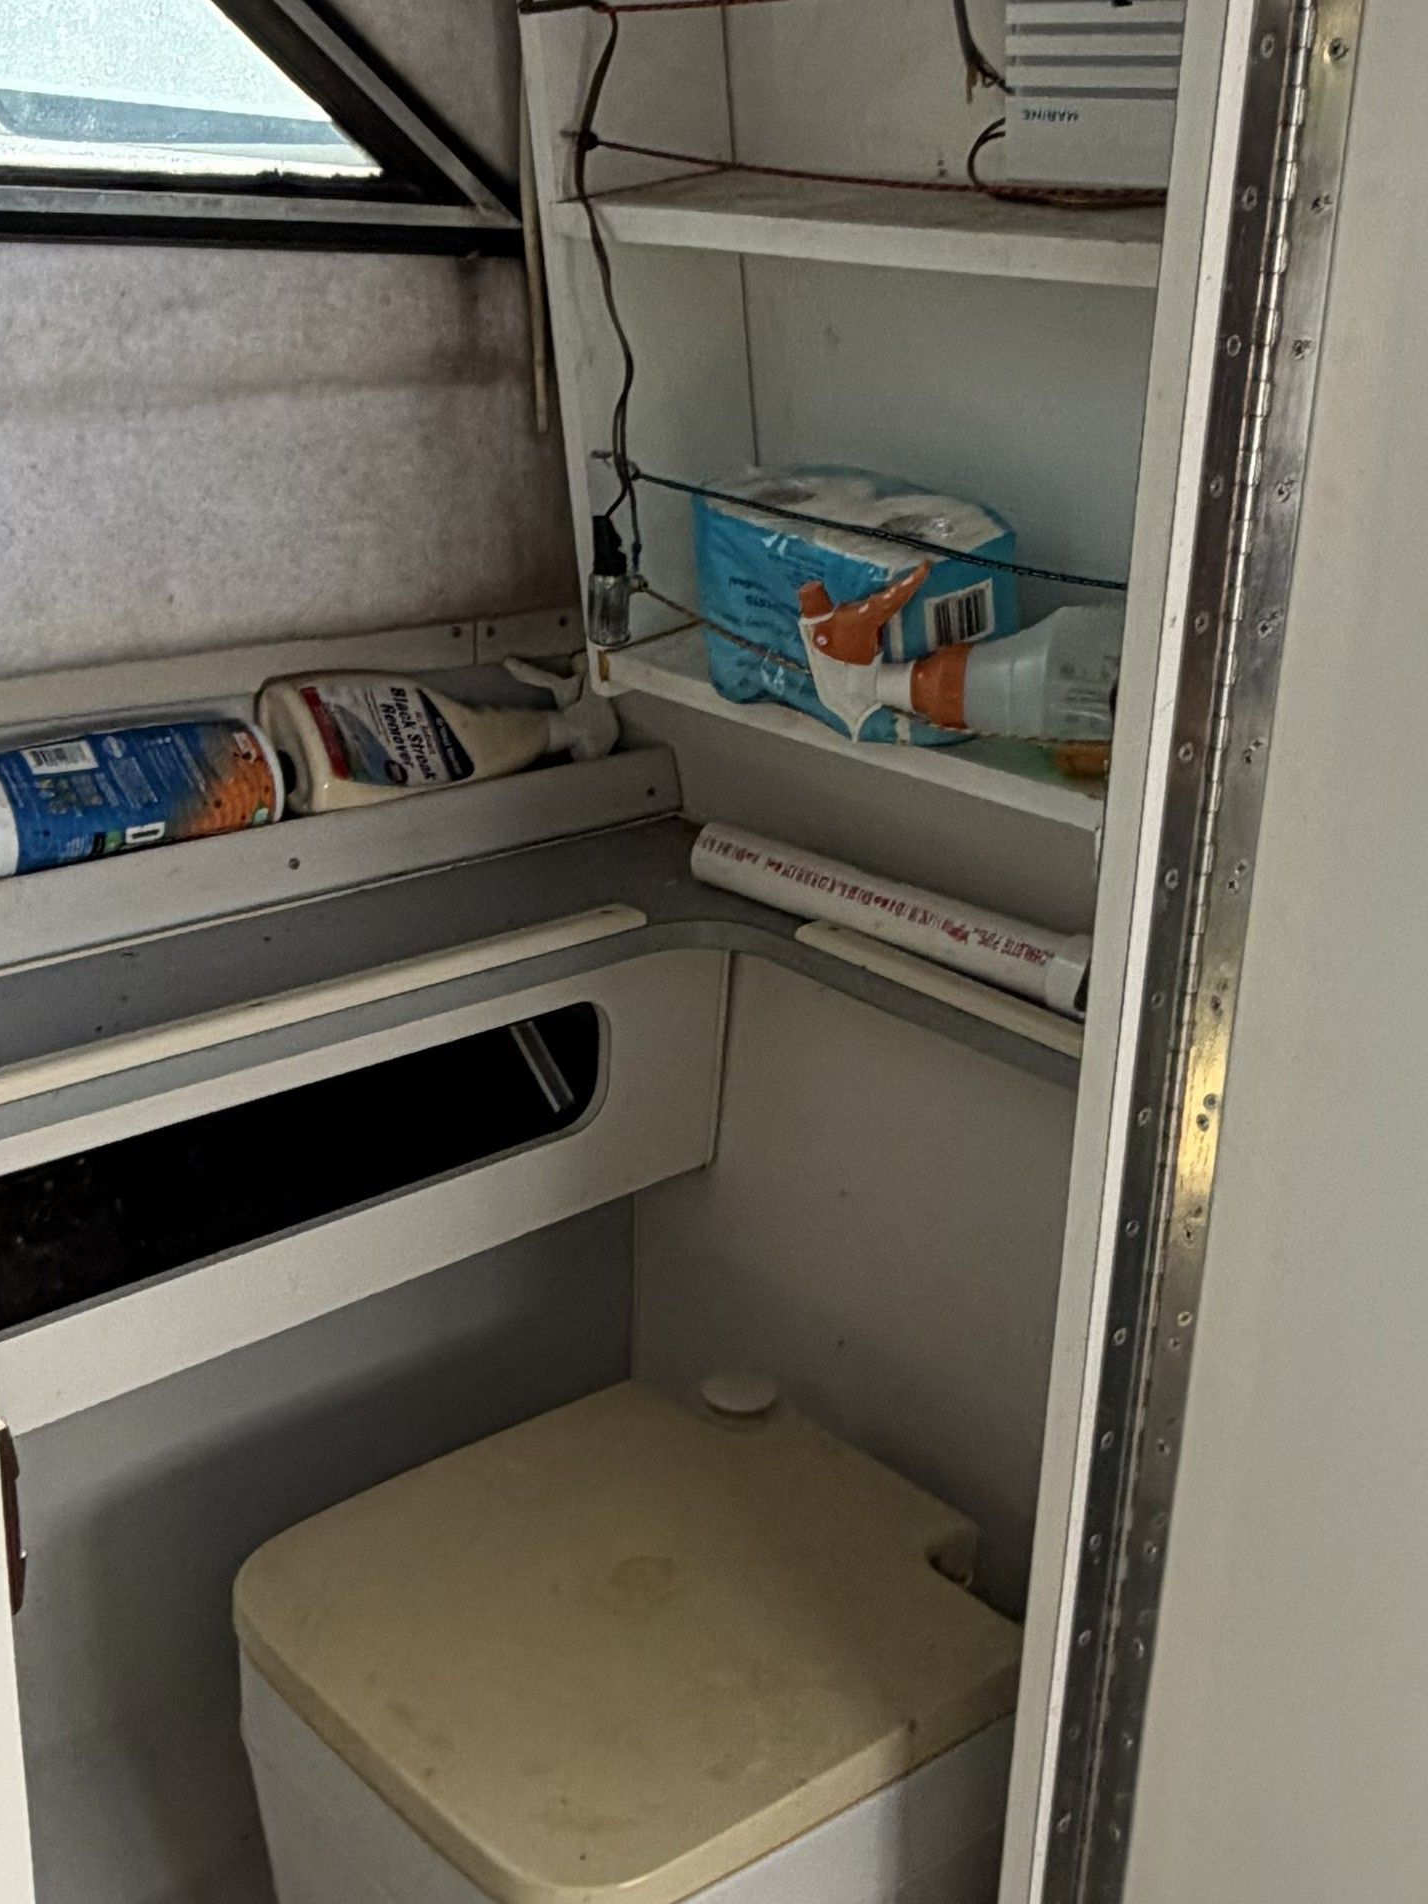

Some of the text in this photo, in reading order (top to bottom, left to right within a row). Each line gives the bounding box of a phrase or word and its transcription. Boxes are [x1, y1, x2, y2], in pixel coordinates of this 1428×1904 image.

[380, 703, 415, 770] Remover
[390, 687, 417, 729] Black
[407, 734, 437, 780] Streak
